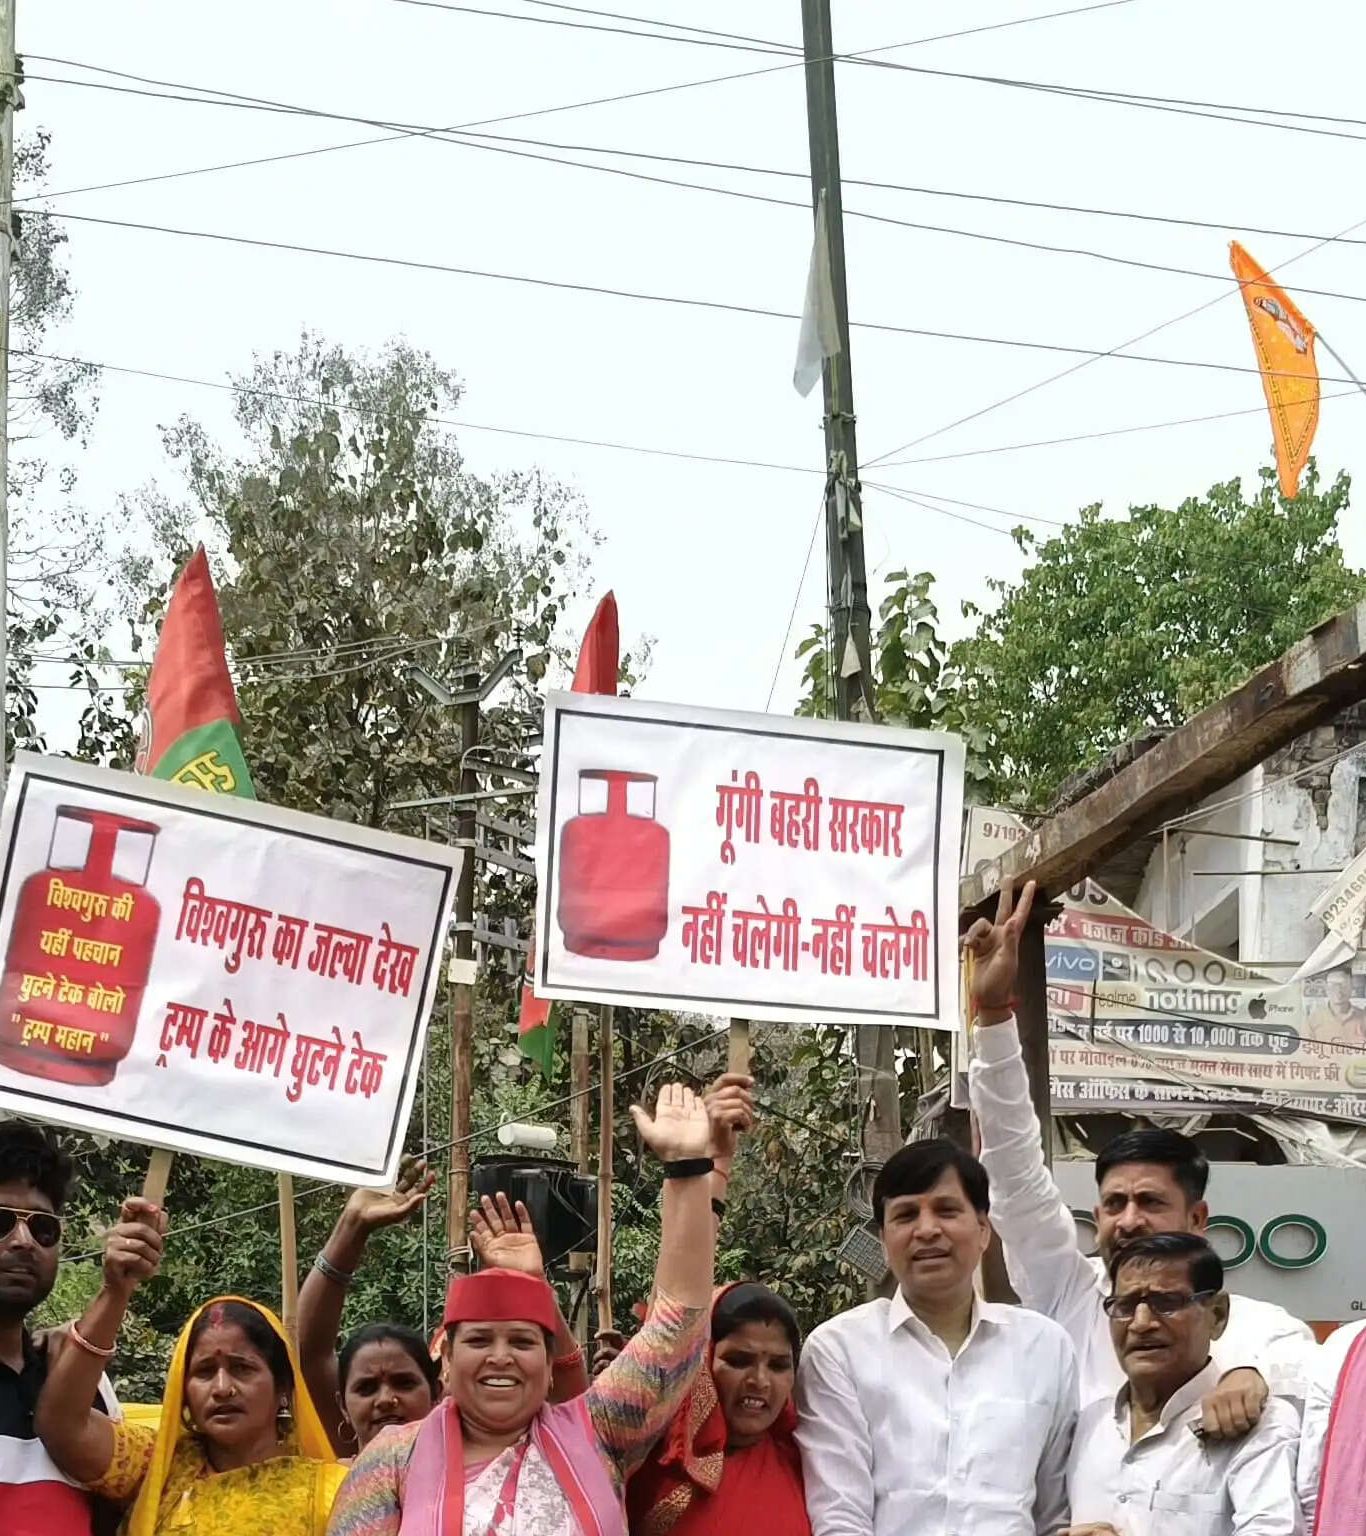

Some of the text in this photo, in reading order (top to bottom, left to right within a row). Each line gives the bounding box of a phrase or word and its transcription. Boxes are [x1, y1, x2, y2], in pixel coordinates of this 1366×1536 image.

[716, 770, 905, 865] गूंगी बहरी सरकार
[47, 878, 134, 922] विश्वगुरु की
[73, 937, 123, 967] पहचान
[175, 877, 272, 974] विश्वगुरु
[272, 914, 308, 969] का
[373, 922, 420, 997] देख
[682, 891, 727, 965] नहीं
[861, 906, 929, 981] चलेगी
[18, 972, 126, 1014] घुटने टेक बोलो
[55, 1024, 97, 1053] महान
[155, 998, 387, 1102] ट्रम्प के आगे घुटने टेक
[1137, 1023, 1169, 1043] 1000
[1190, 1026, 1235, 1049] 10,000
